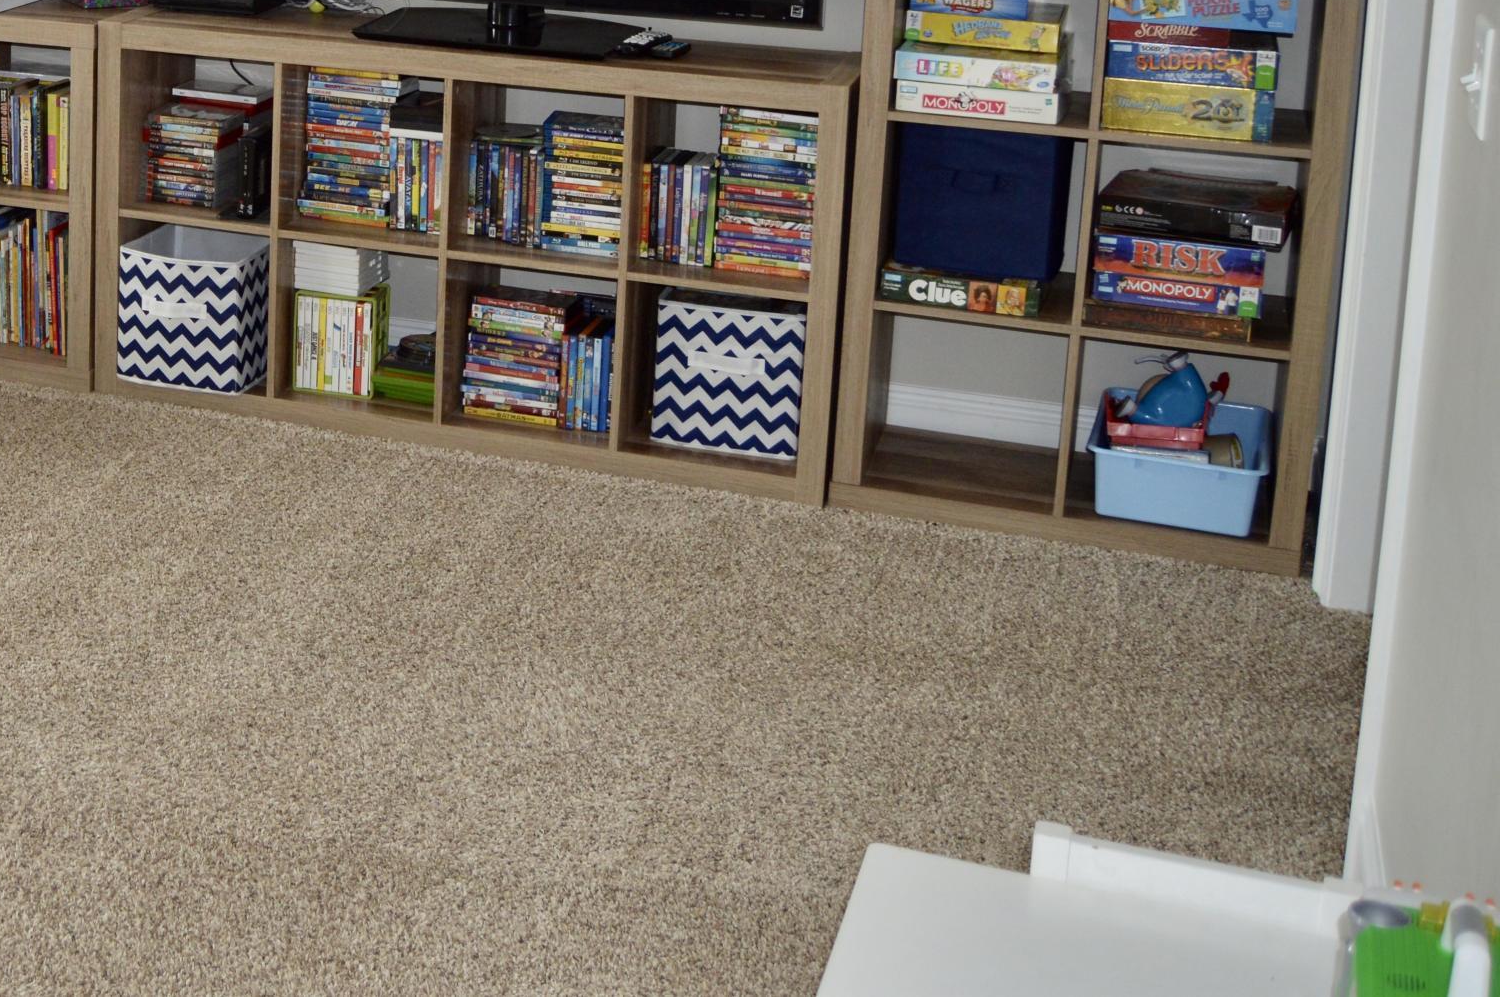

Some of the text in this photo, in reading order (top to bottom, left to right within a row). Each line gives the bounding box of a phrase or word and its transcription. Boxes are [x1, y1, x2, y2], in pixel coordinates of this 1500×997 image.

[1192, 3, 1241, 17] PUZZLE
[1134, 23, 1199, 39] SCRABBLE
[918, 60, 962, 77] LIFE
[923, 96, 1005, 114] MONOPOLY
[1131, 239, 1227, 275] RISK
[908, 279, 967, 307] Clue
[1127, 280, 1212, 299] MONOPOLY
